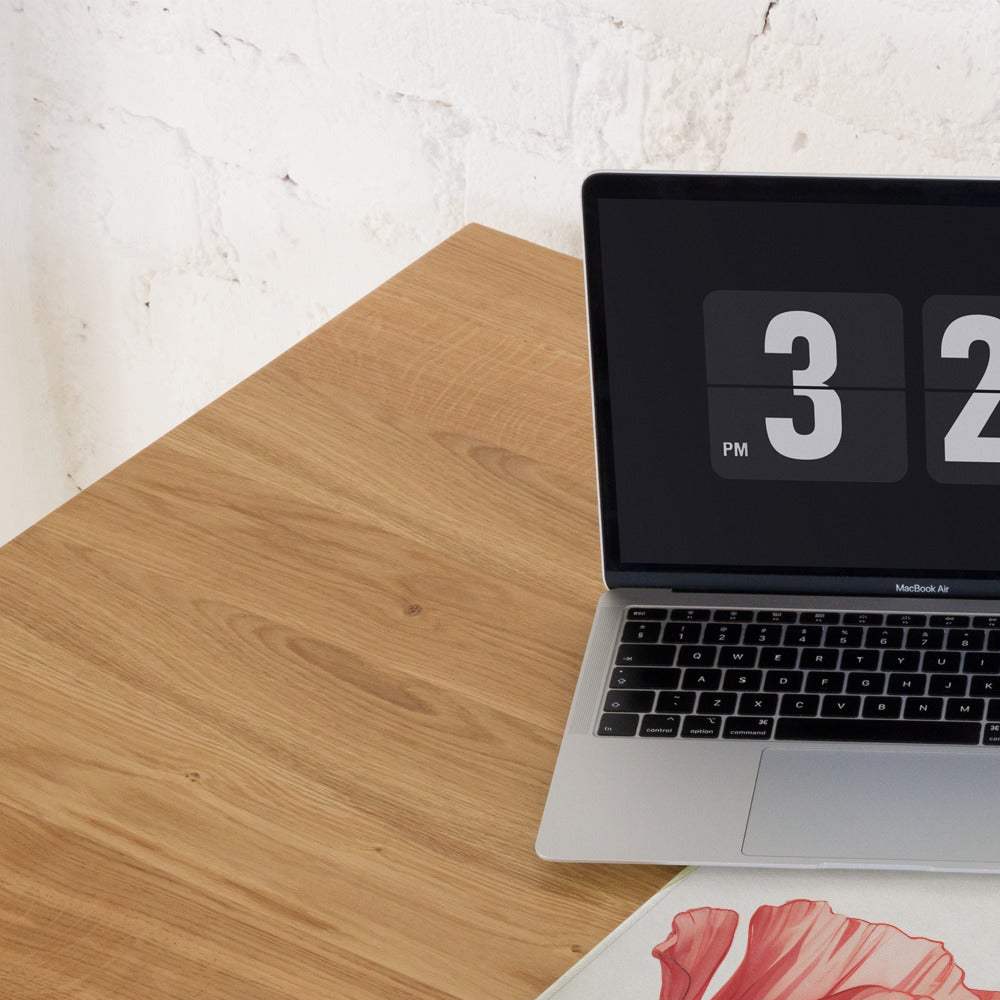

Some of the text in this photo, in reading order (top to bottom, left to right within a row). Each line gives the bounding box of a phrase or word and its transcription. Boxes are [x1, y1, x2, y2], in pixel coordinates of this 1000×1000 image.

[764, 310, 842, 460] 3
[723, 442, 748, 457] PM
[896, 584, 949, 592] MacBook Air
